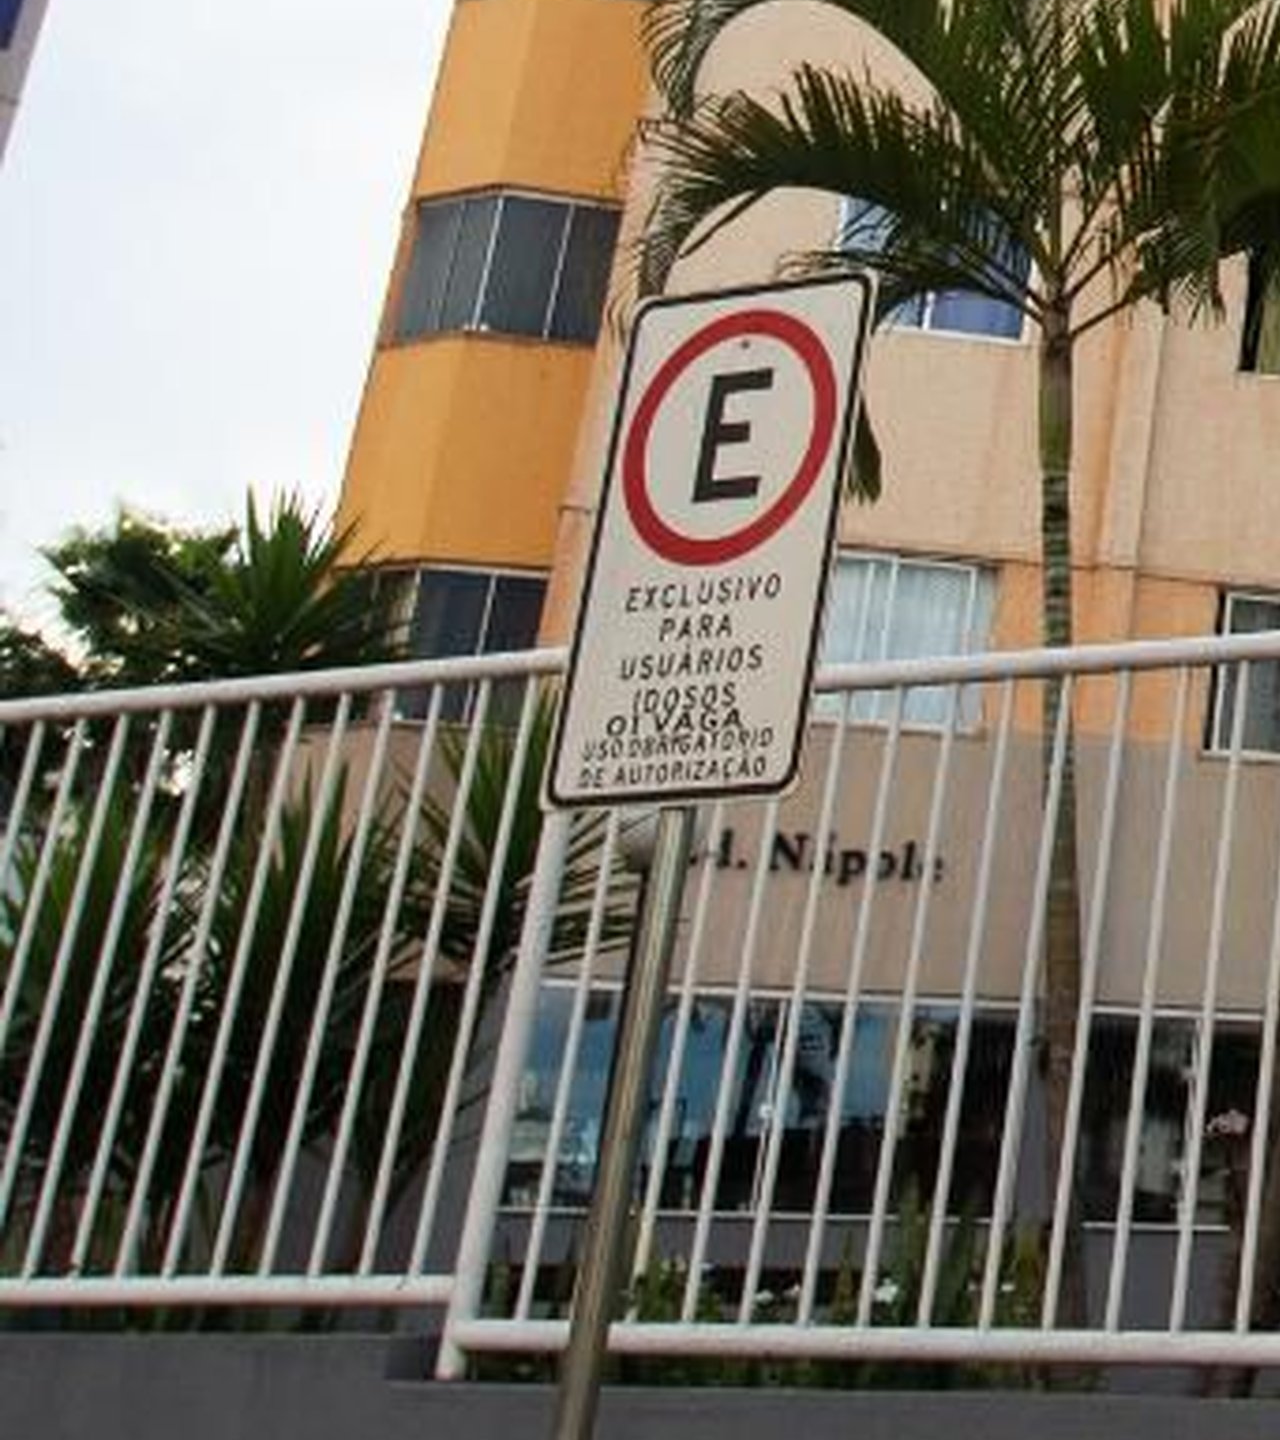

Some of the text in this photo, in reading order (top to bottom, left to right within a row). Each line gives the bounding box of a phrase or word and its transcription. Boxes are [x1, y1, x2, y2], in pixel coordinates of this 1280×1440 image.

[693, 367, 774, 504] E
[625, 573, 781, 613] EXCLUSIVO
[659, 614, 732, 642] PARA
[620, 644, 764, 680] USUÁRIOS
[633, 682, 737, 715] IDOSOS
[655, 708, 744, 732] VAGA
